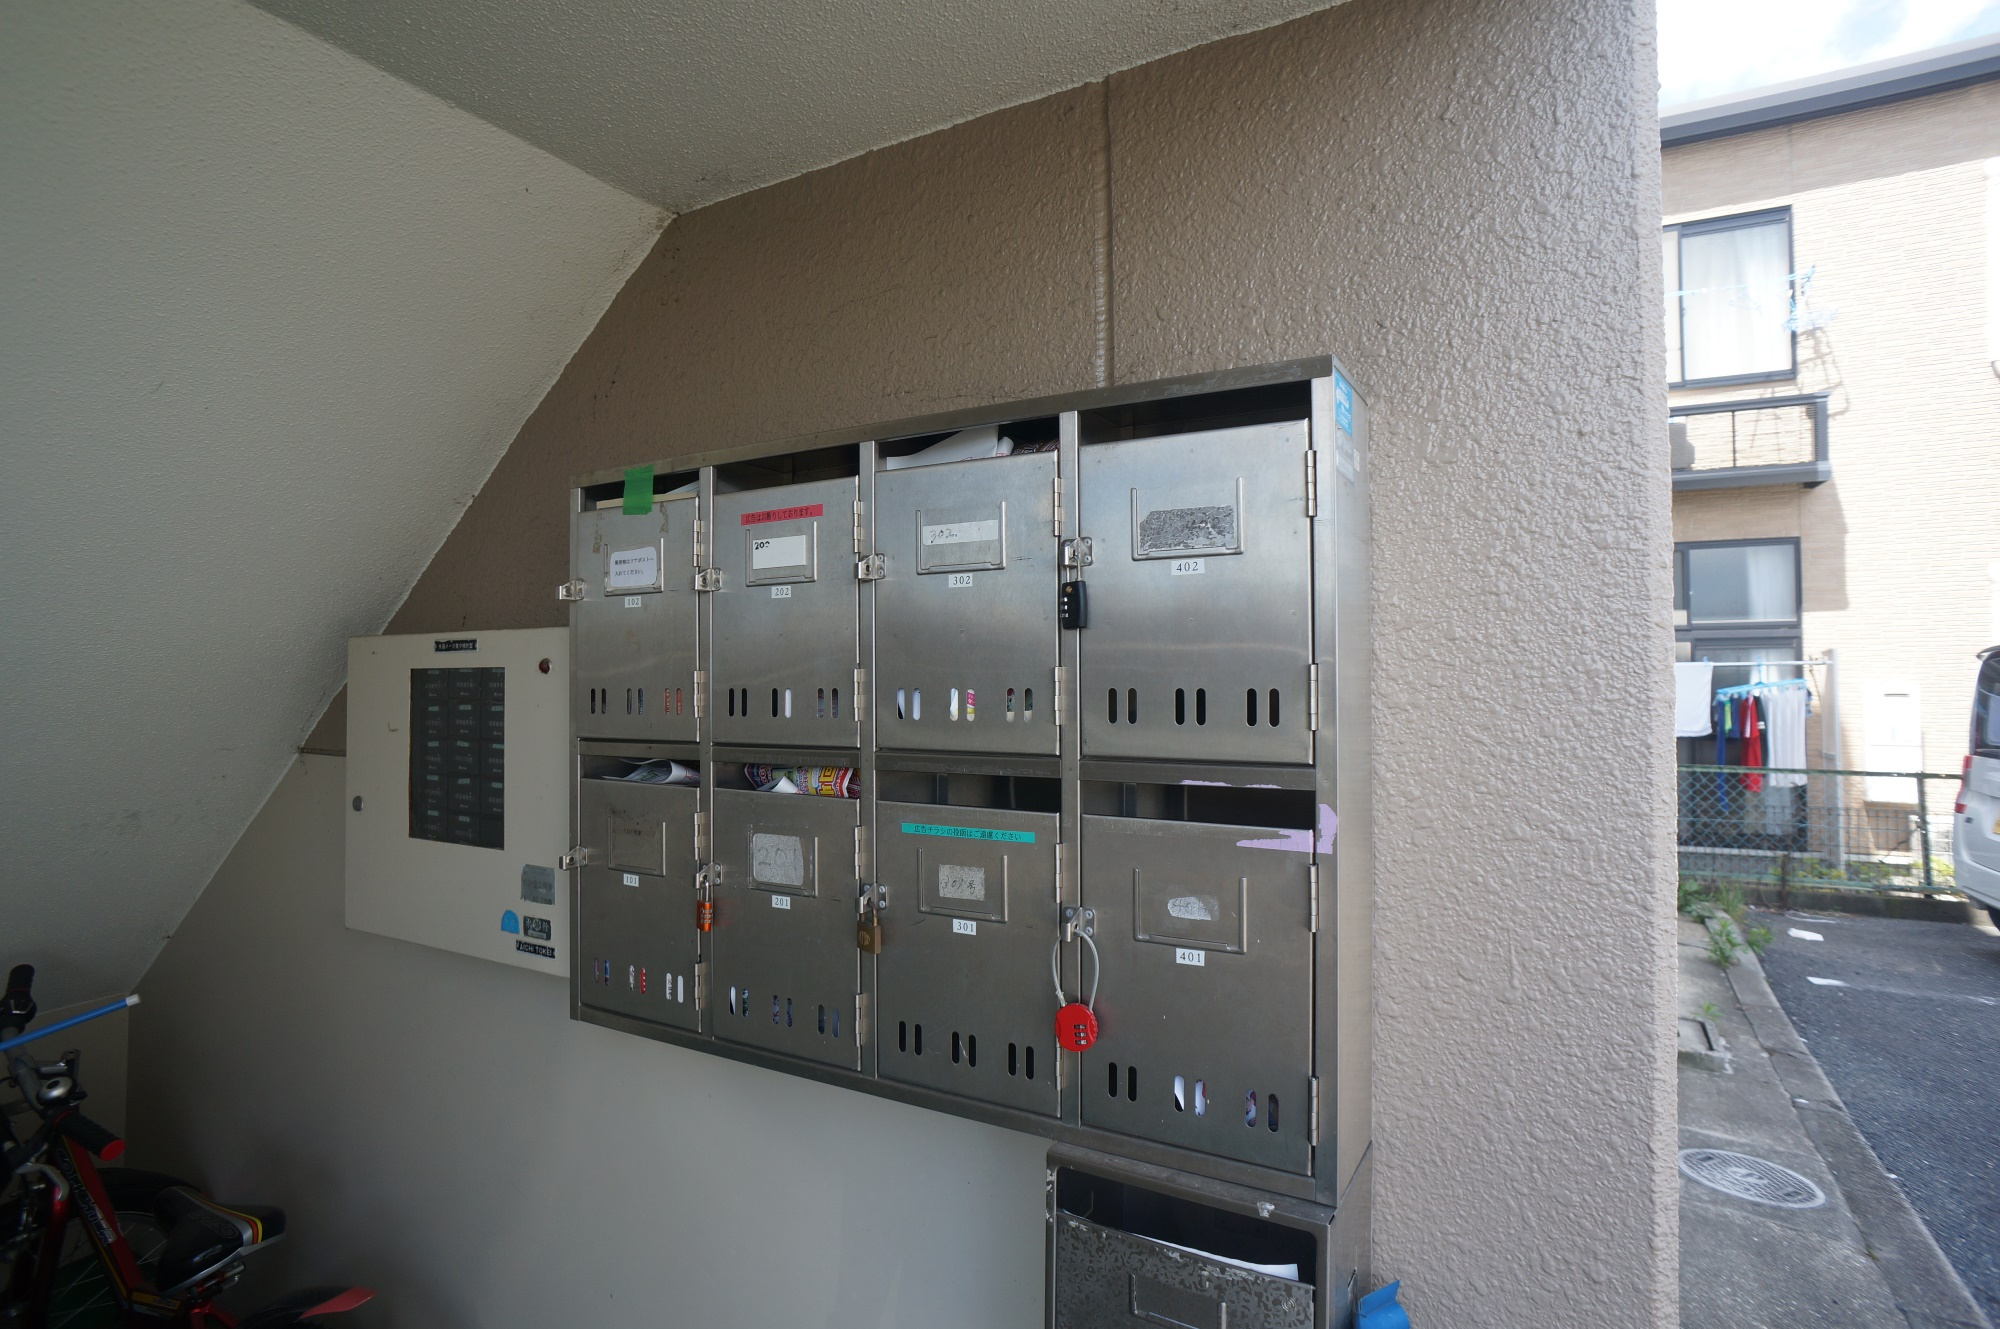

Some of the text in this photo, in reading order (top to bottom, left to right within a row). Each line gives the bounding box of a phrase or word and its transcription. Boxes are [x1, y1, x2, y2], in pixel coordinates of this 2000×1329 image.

[1176, 561, 1200, 572] 402
[953, 575, 971, 586] 302
[775, 587, 790, 597] 202
[627, 597, 640, 606] 102
[914, 825, 1022, 841] 広告チラシの投函はご遠慮ください
[626, 875, 637, 885] 101
[775, 897, 789, 907] 201
[957, 921, 974, 933] 301
[1179, 951, 1202, 963] 401
